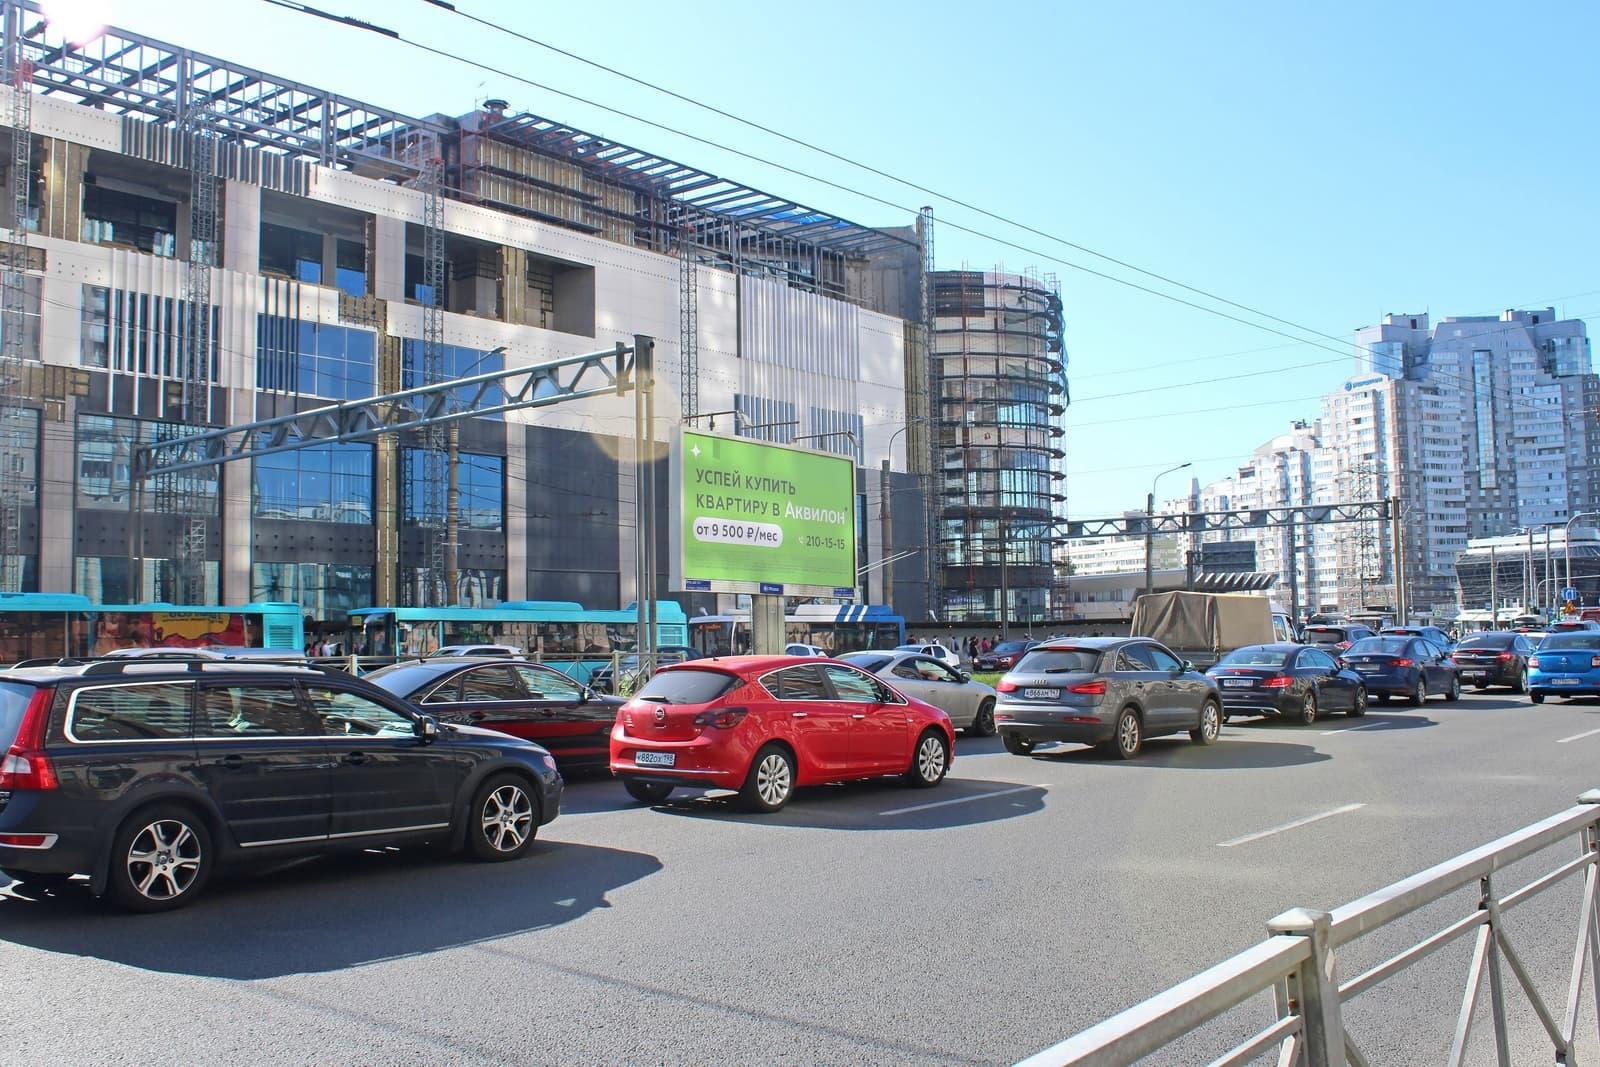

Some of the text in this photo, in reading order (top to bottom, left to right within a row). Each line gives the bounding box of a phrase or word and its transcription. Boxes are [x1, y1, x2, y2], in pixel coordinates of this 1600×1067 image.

[696, 468, 796, 496] УСПЕЙ КУПИТЬ
[696, 493, 845, 526] КВАРТИРУ В Аквилон
[696, 525, 709, 536] от
[712, 523, 719, 536] 9
[722, 524, 744, 539] 500
[806, 535, 846, 551] 210-15-15
